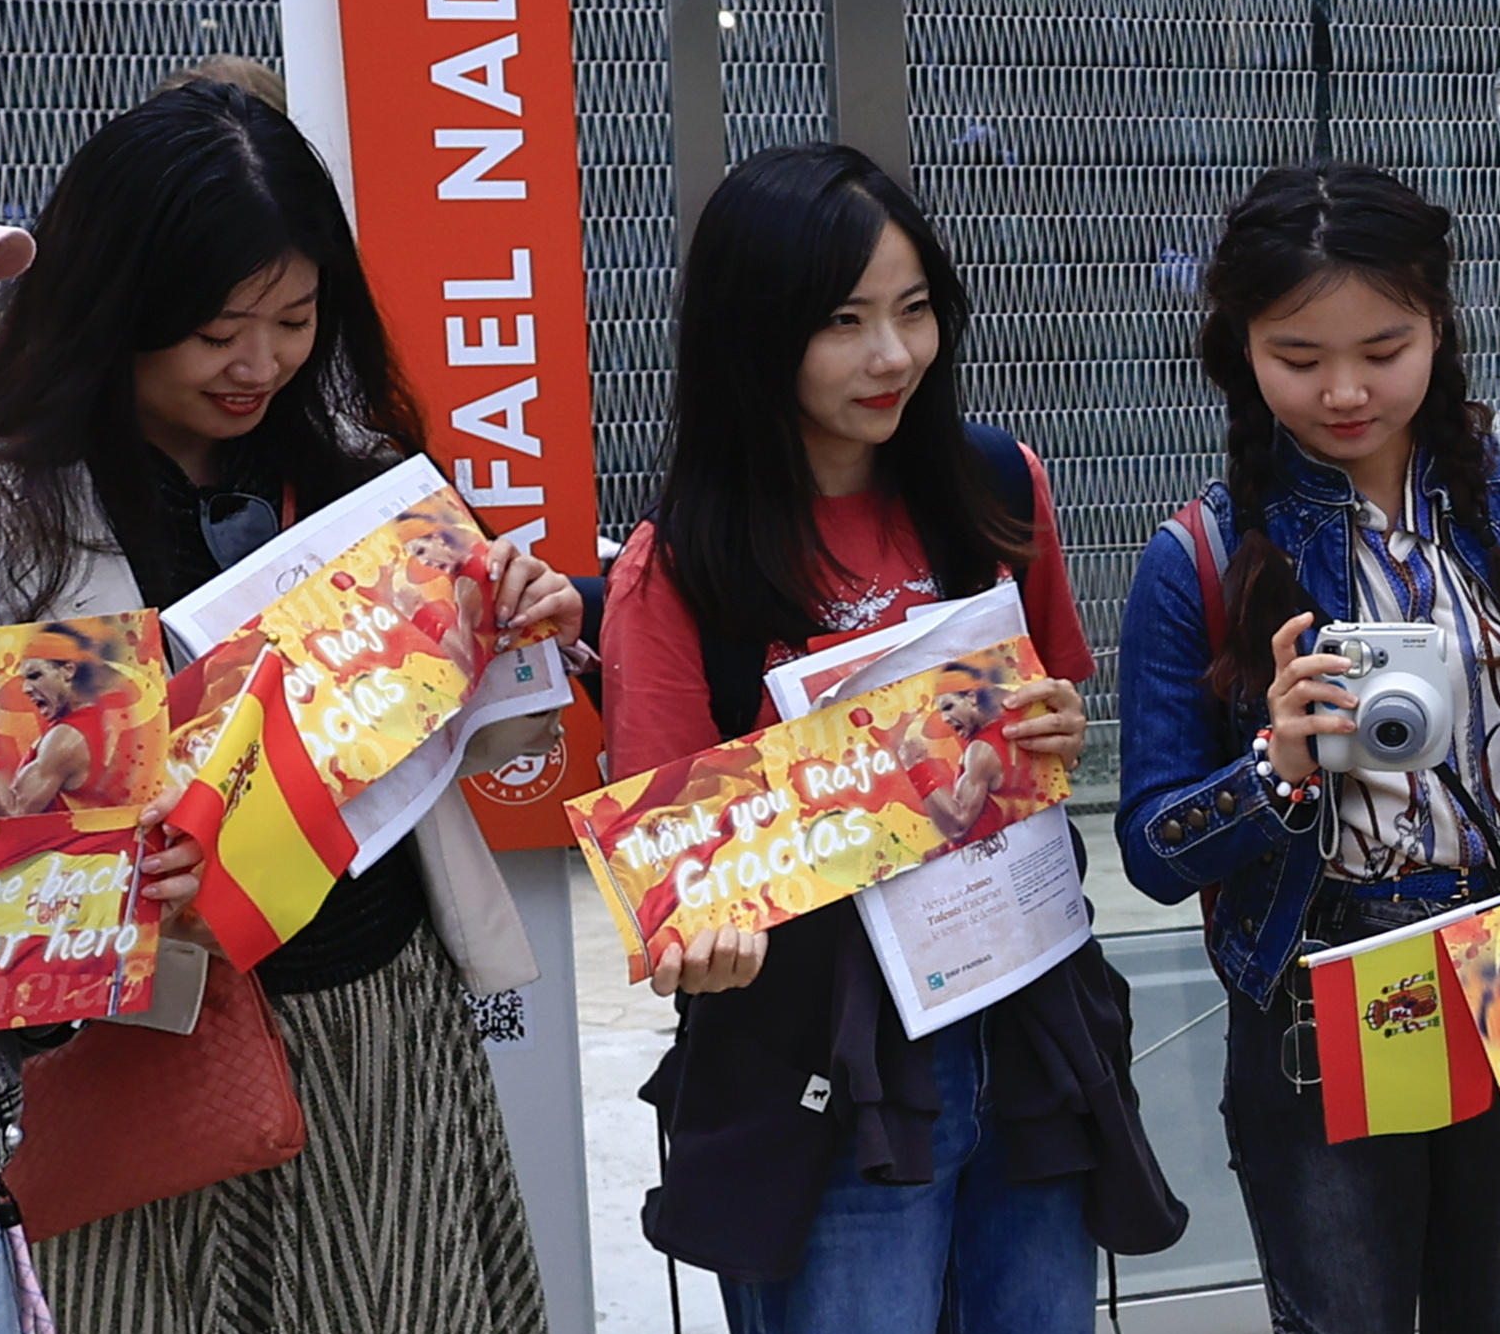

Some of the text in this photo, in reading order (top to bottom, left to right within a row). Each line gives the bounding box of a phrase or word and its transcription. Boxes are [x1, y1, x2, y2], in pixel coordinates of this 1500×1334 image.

[315, 604, 399, 668] Rafa
[300, 667, 406, 767] acias
[486, 779, 550, 799] PARIS
[615, 741, 897, 870] Thank you Rafa
[36, 849, 134, 904] back
[674, 807, 873, 910] Gracias
[43, 917, 141, 963] hero
